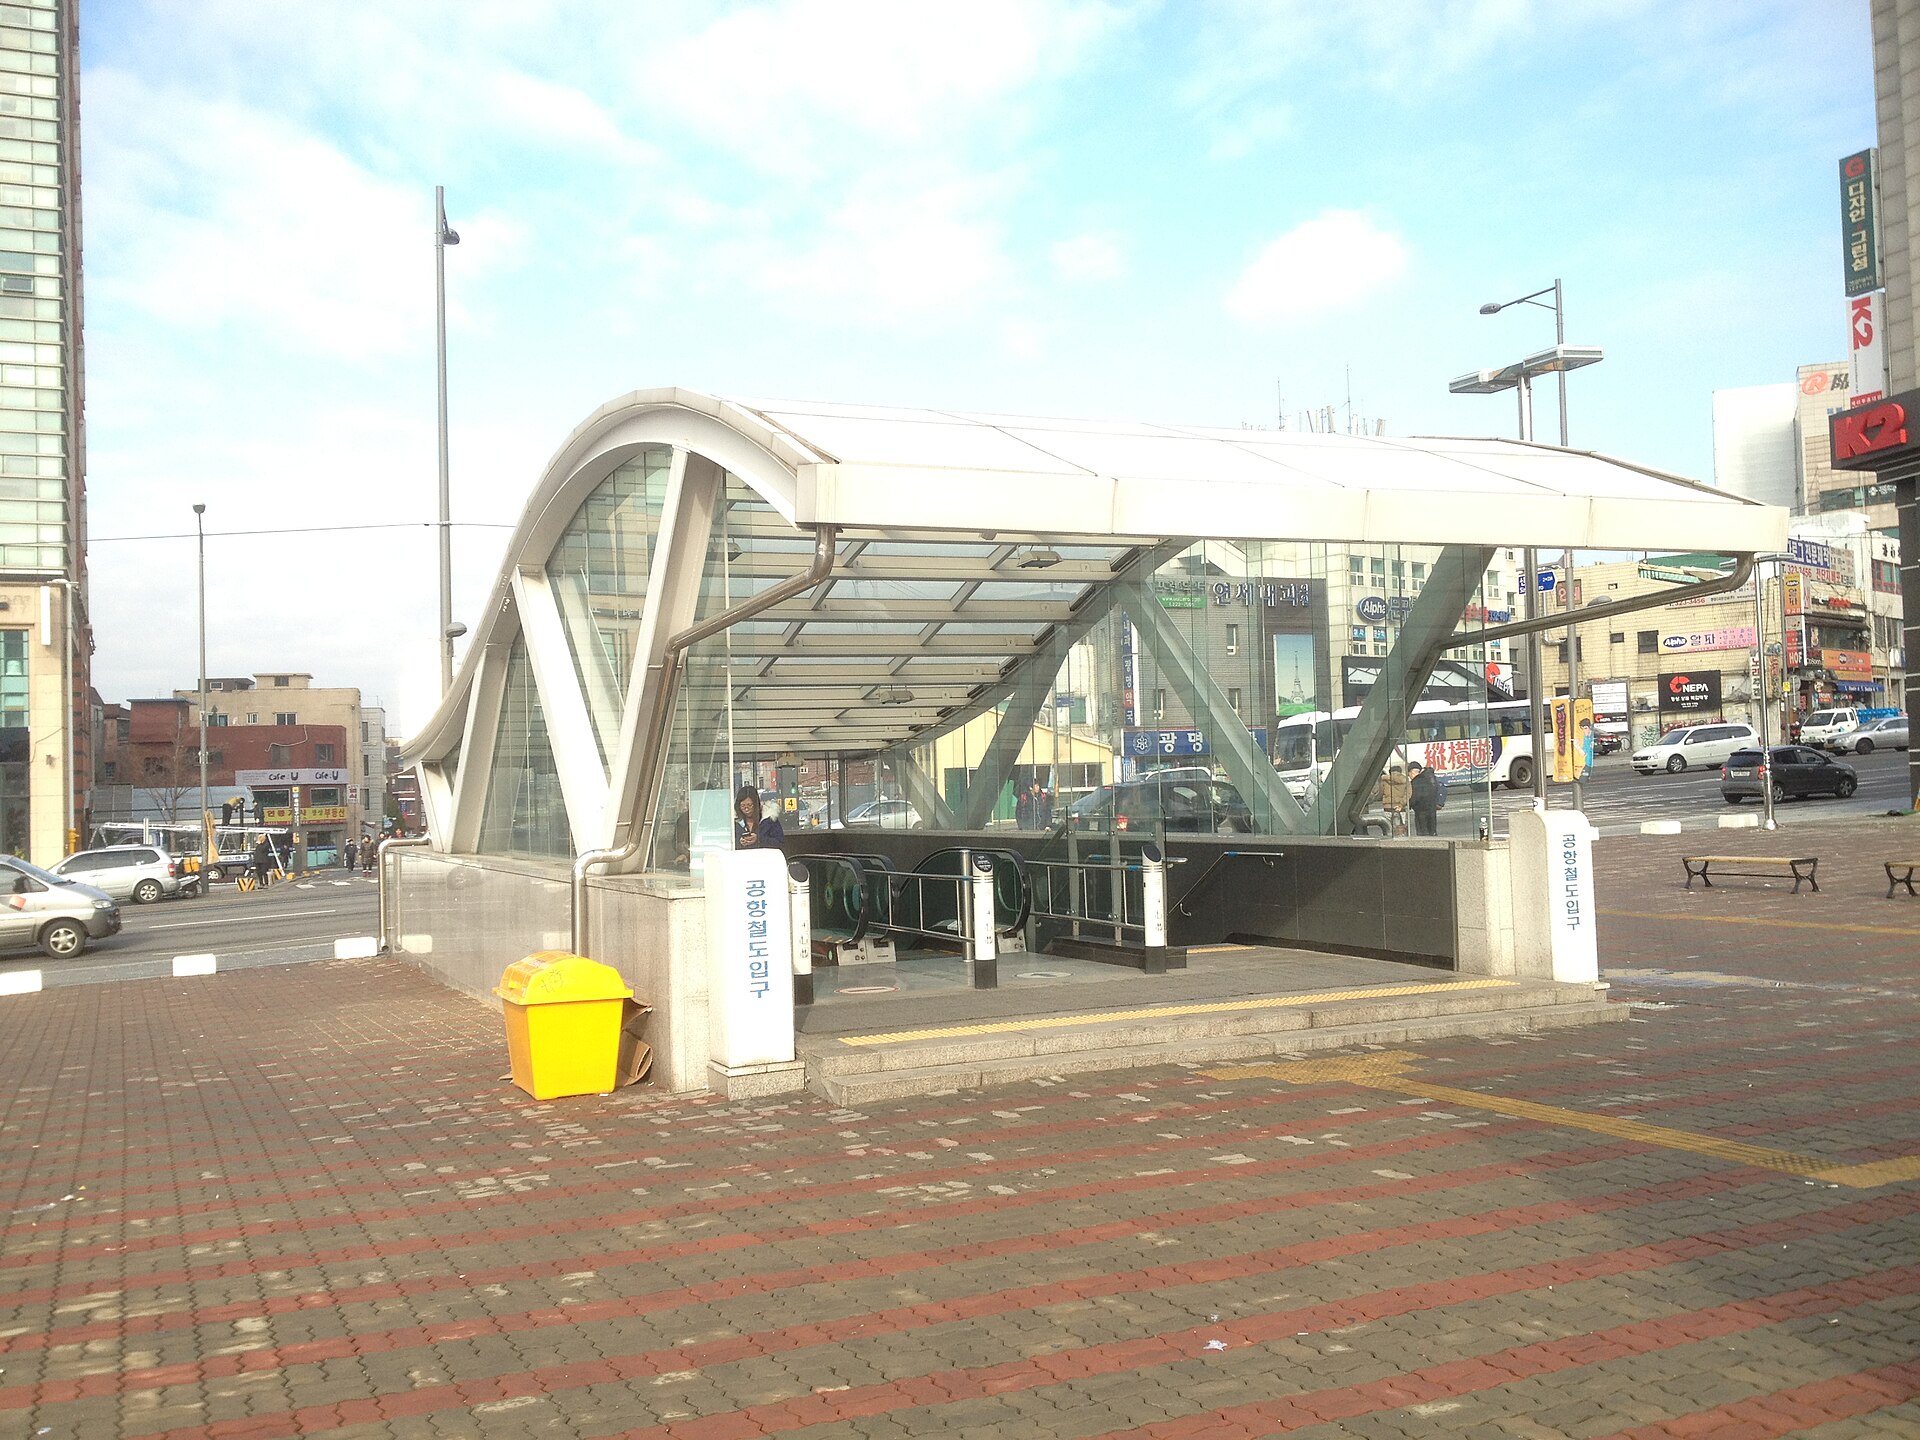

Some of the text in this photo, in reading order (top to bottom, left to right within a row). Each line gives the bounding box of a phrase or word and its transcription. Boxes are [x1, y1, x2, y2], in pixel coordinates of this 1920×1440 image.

[1849, 181, 1866, 223] 디자인
[1852, 297, 1873, 350] K2
[1834, 403, 1908, 459] K2
[1664, 637, 1687, 647] Alpha
[1690, 633, 1715, 646] 알파
[1788, 651, 1803, 665] HOF
[1682, 683, 1709, 693] NEPA
[324, 808, 345, 818] 부동산
[1562, 833, 1580, 930] 공항철도입구
[746, 879, 770, 999] 공항철도입구
